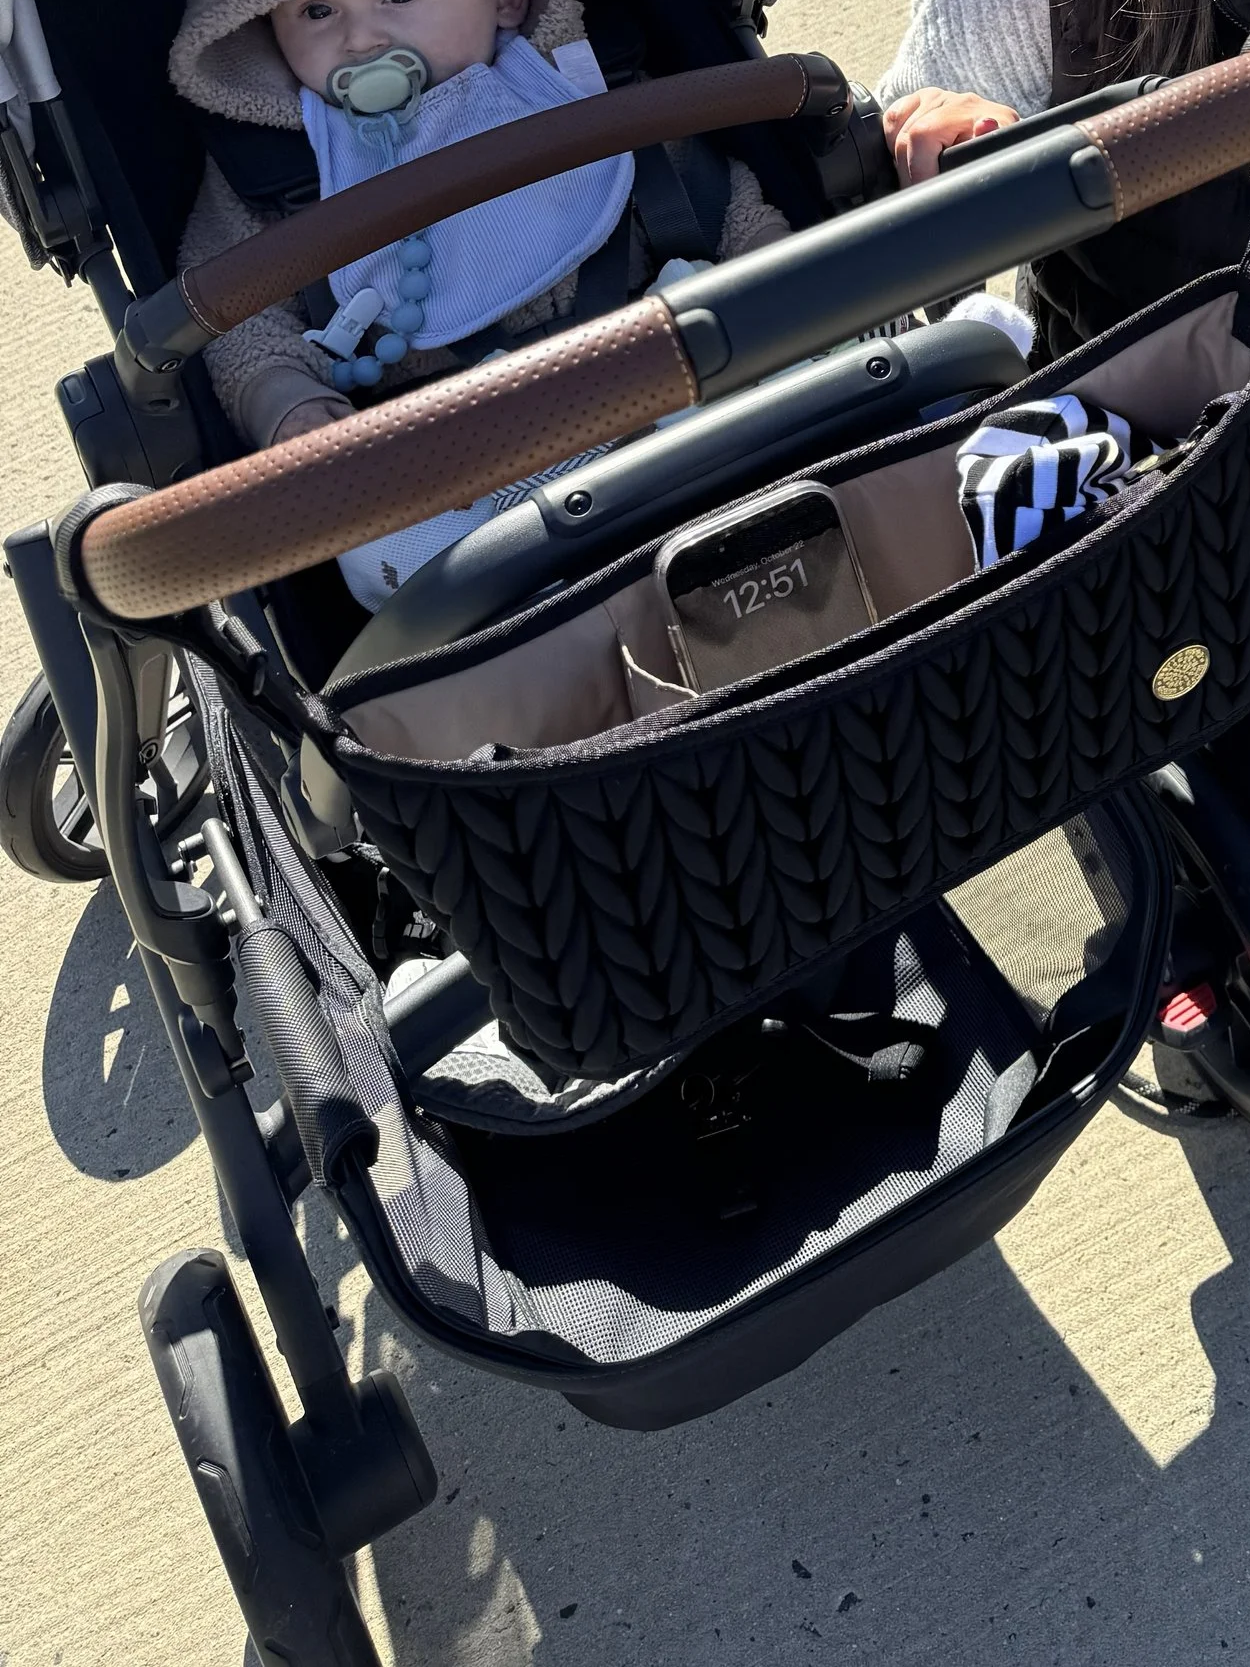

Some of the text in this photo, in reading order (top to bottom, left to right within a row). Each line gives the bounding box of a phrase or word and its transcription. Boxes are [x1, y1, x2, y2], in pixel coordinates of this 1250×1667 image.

[711, 539, 805, 588] Wednesday, October 22
[723, 558, 809, 619] 12:51
